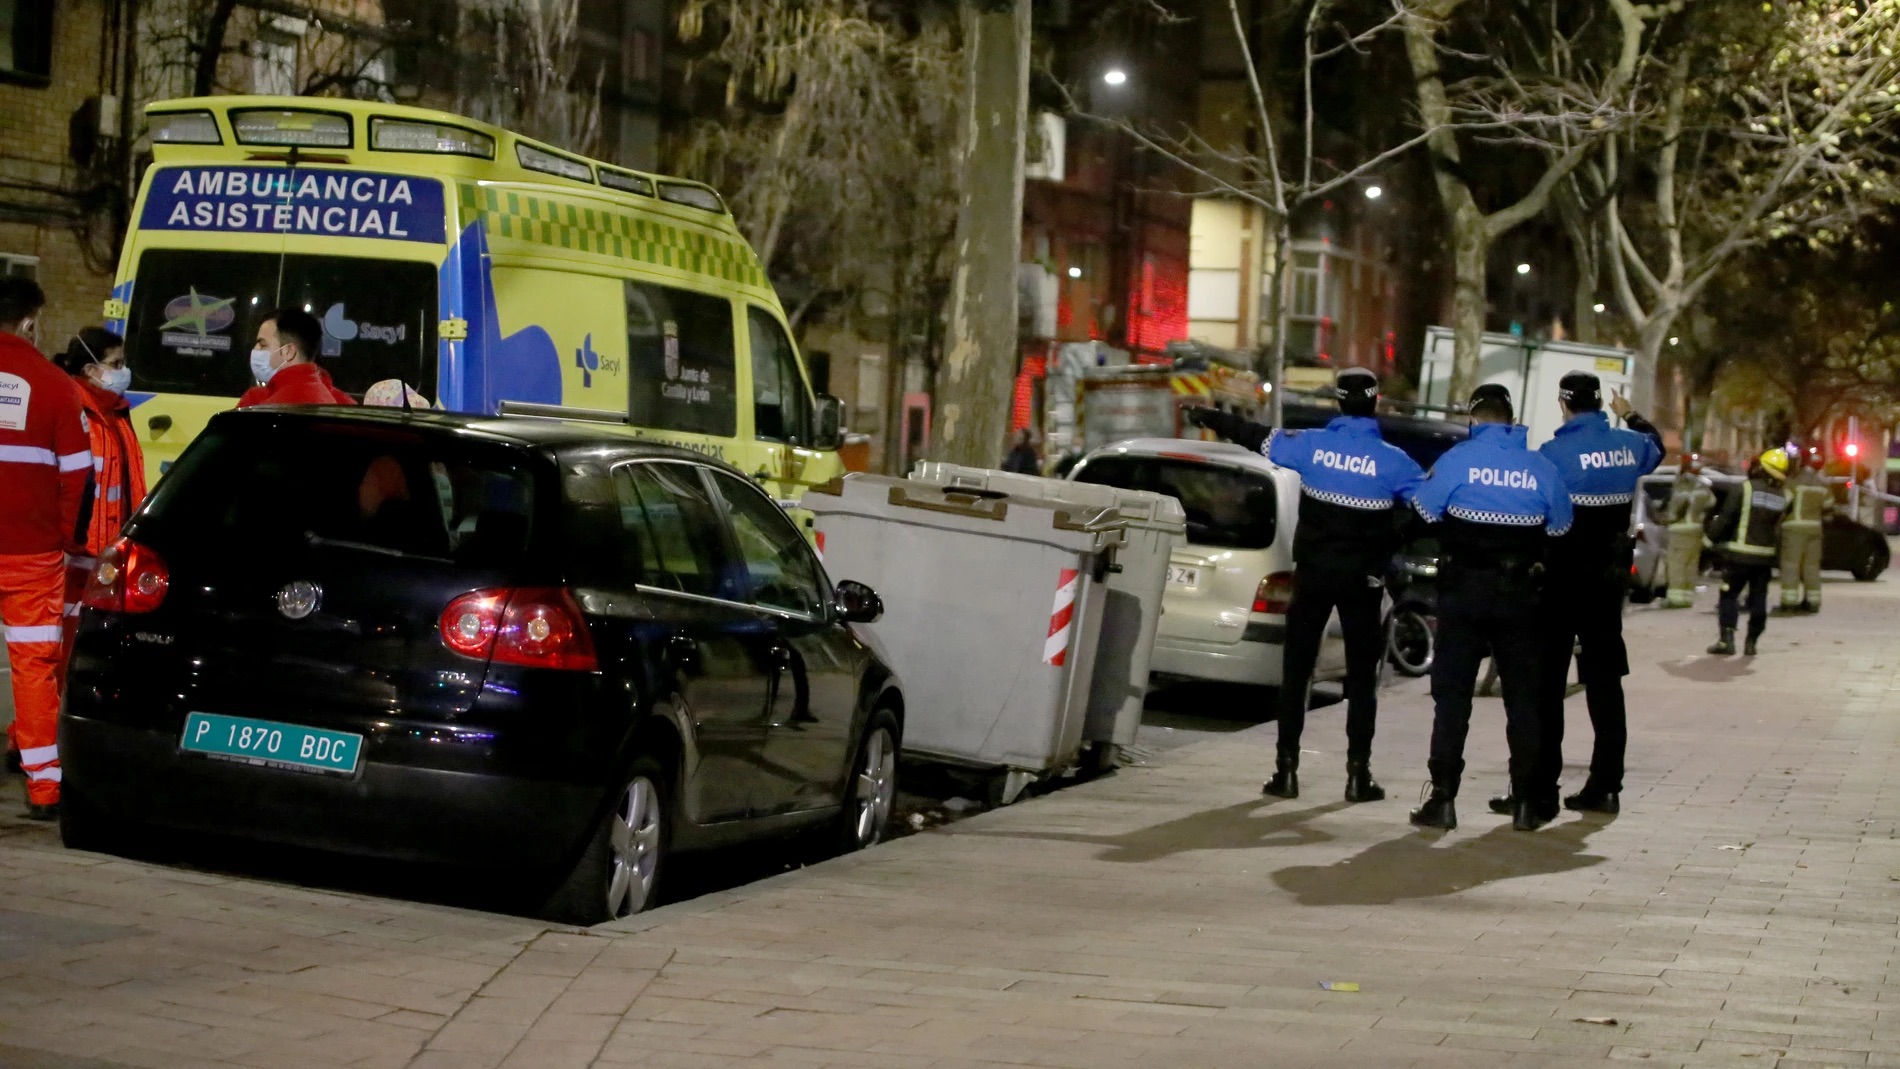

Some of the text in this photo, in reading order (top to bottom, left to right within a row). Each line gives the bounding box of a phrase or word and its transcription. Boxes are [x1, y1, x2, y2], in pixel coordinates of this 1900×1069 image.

[172, 170, 413, 204] AMBULANCIA
[168, 201, 408, 237] ASISTENCIAL
[360, 322, 406, 344] Sacyl
[600, 355, 621, 376] Sacyl
[1312, 449, 1377, 477] POLICÍA
[1579, 446, 1636, 470] POLICÍA
[1468, 467, 1538, 491] POLICÍA
[195, 720, 346, 763] P 1870 BDC
